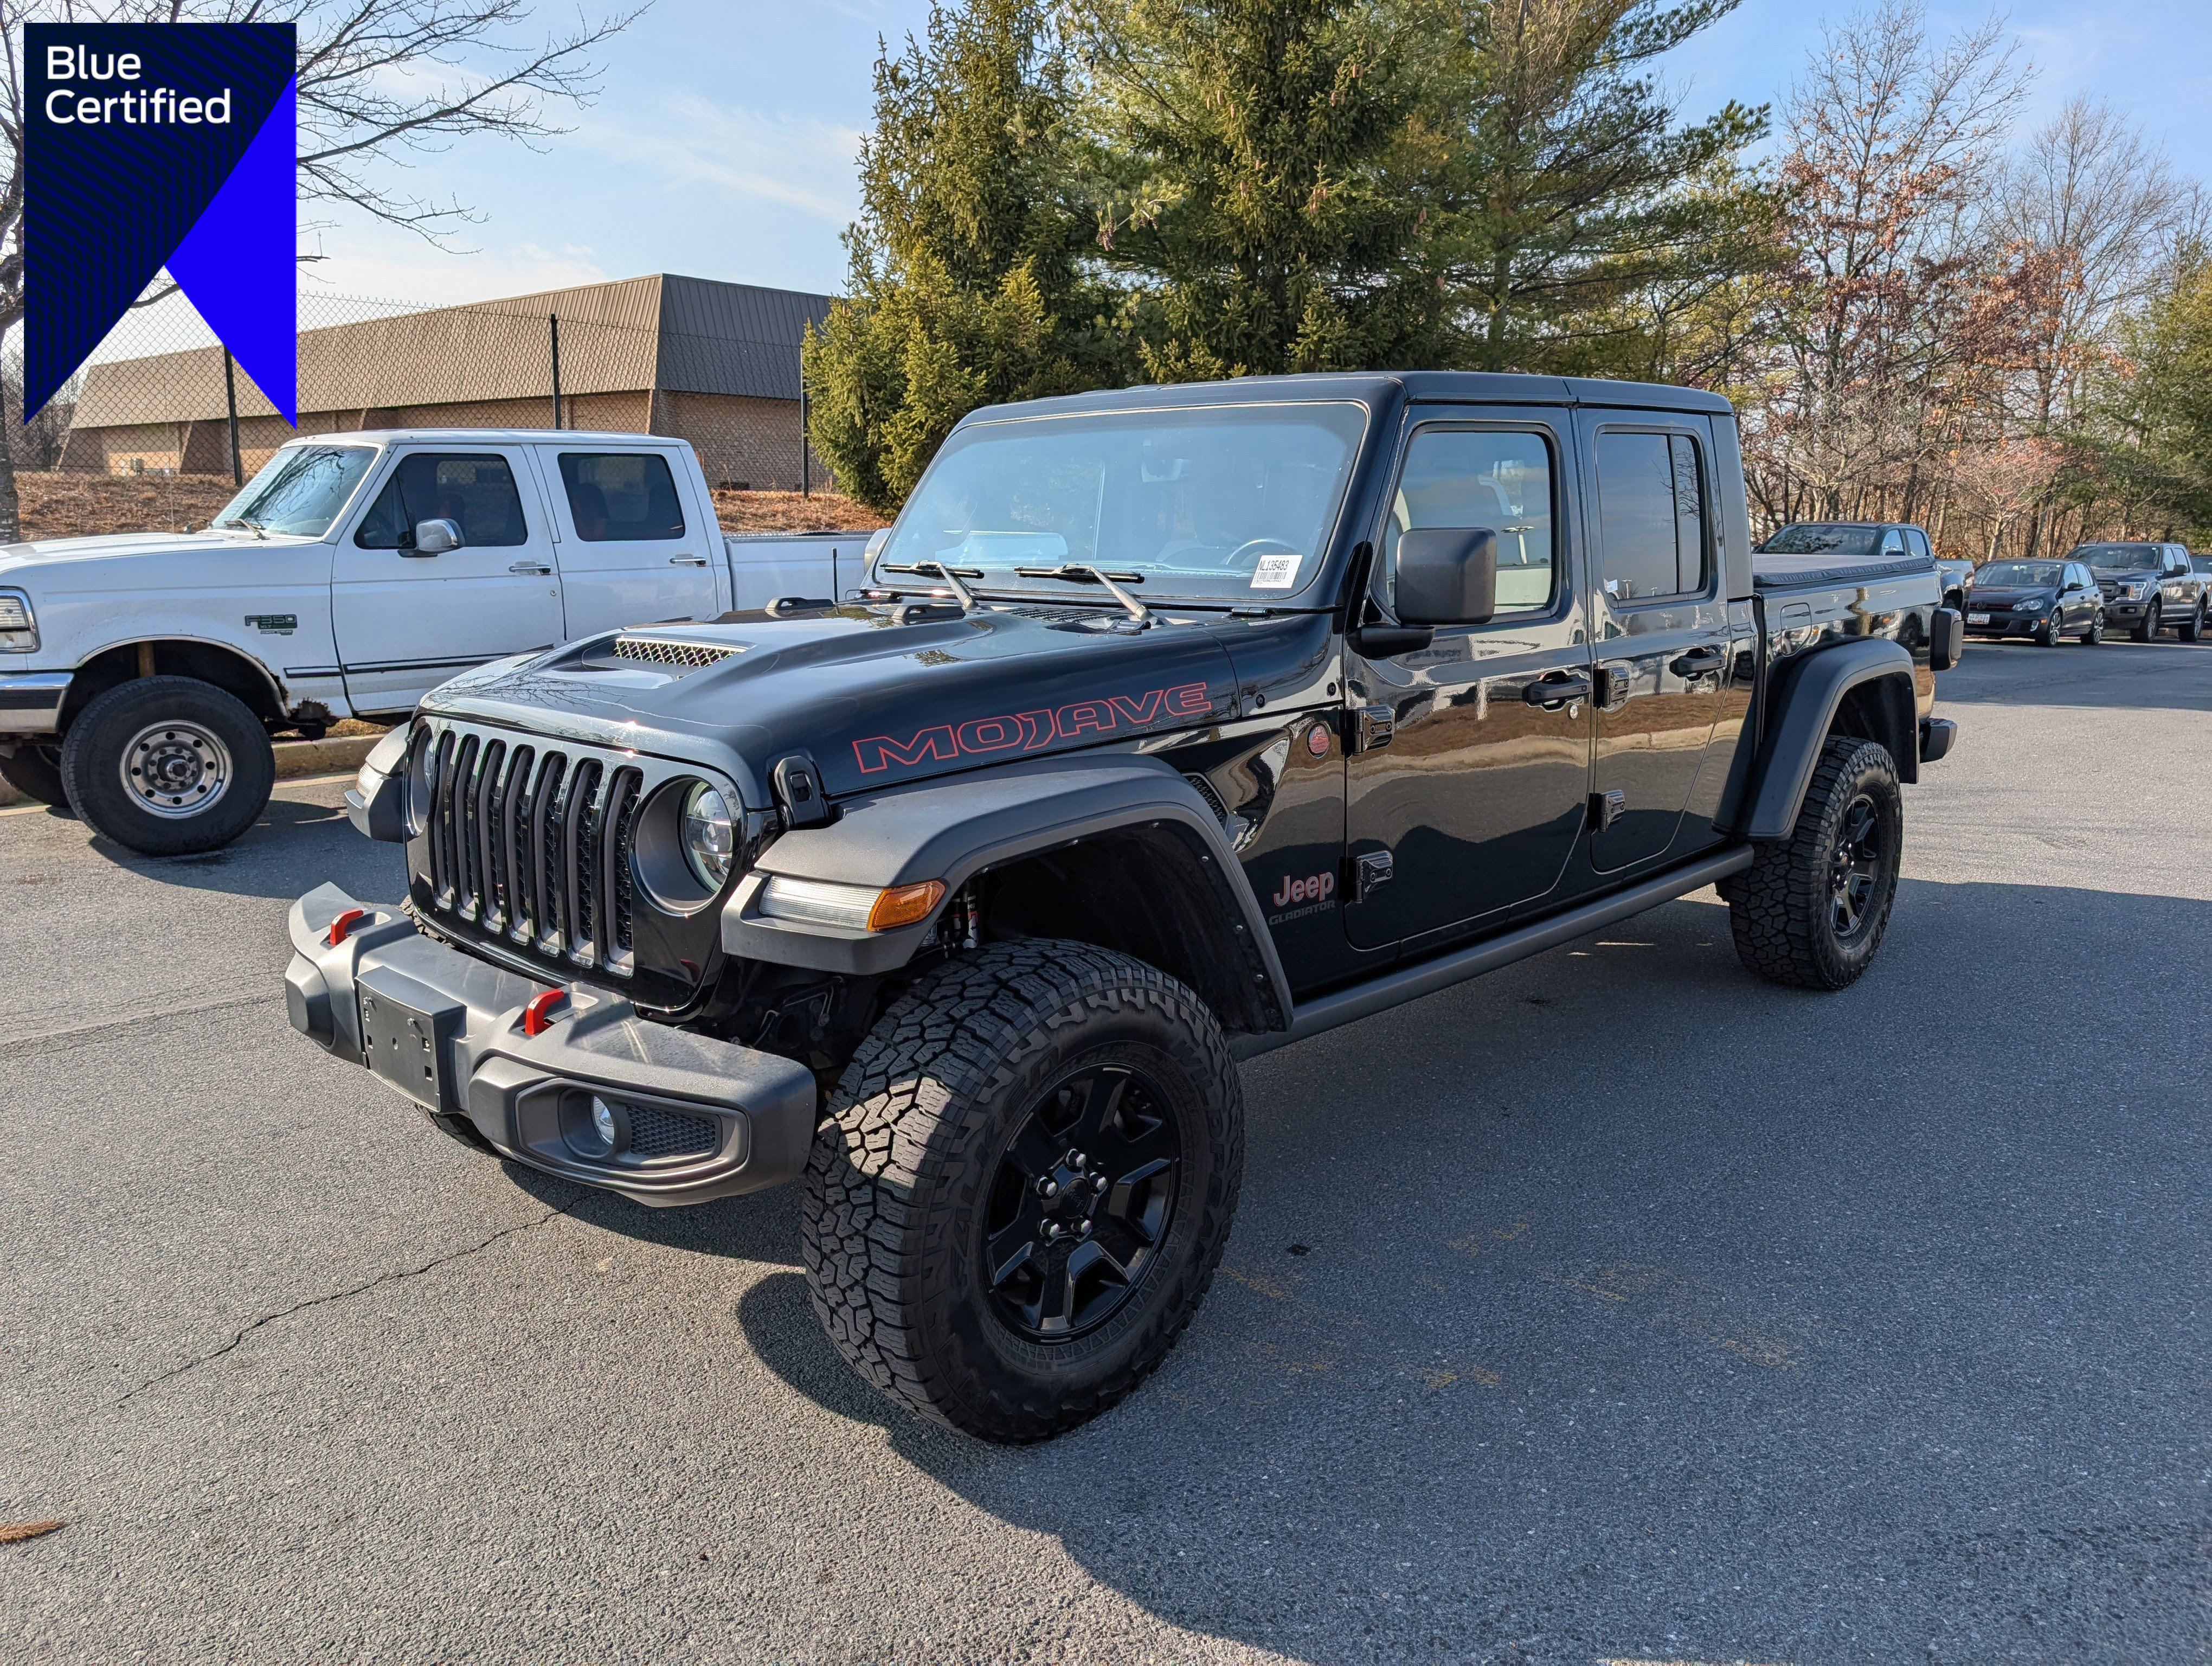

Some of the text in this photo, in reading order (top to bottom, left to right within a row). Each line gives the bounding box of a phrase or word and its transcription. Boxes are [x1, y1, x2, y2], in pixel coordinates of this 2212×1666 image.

[1258, 560, 1289, 571] NL135483
[245, 614, 297, 626] F350
[852, 682, 1211, 773] MOJAVE
[1273, 872, 1334, 907] Jeep
[1269, 900, 1336, 926] GLADIATOR
